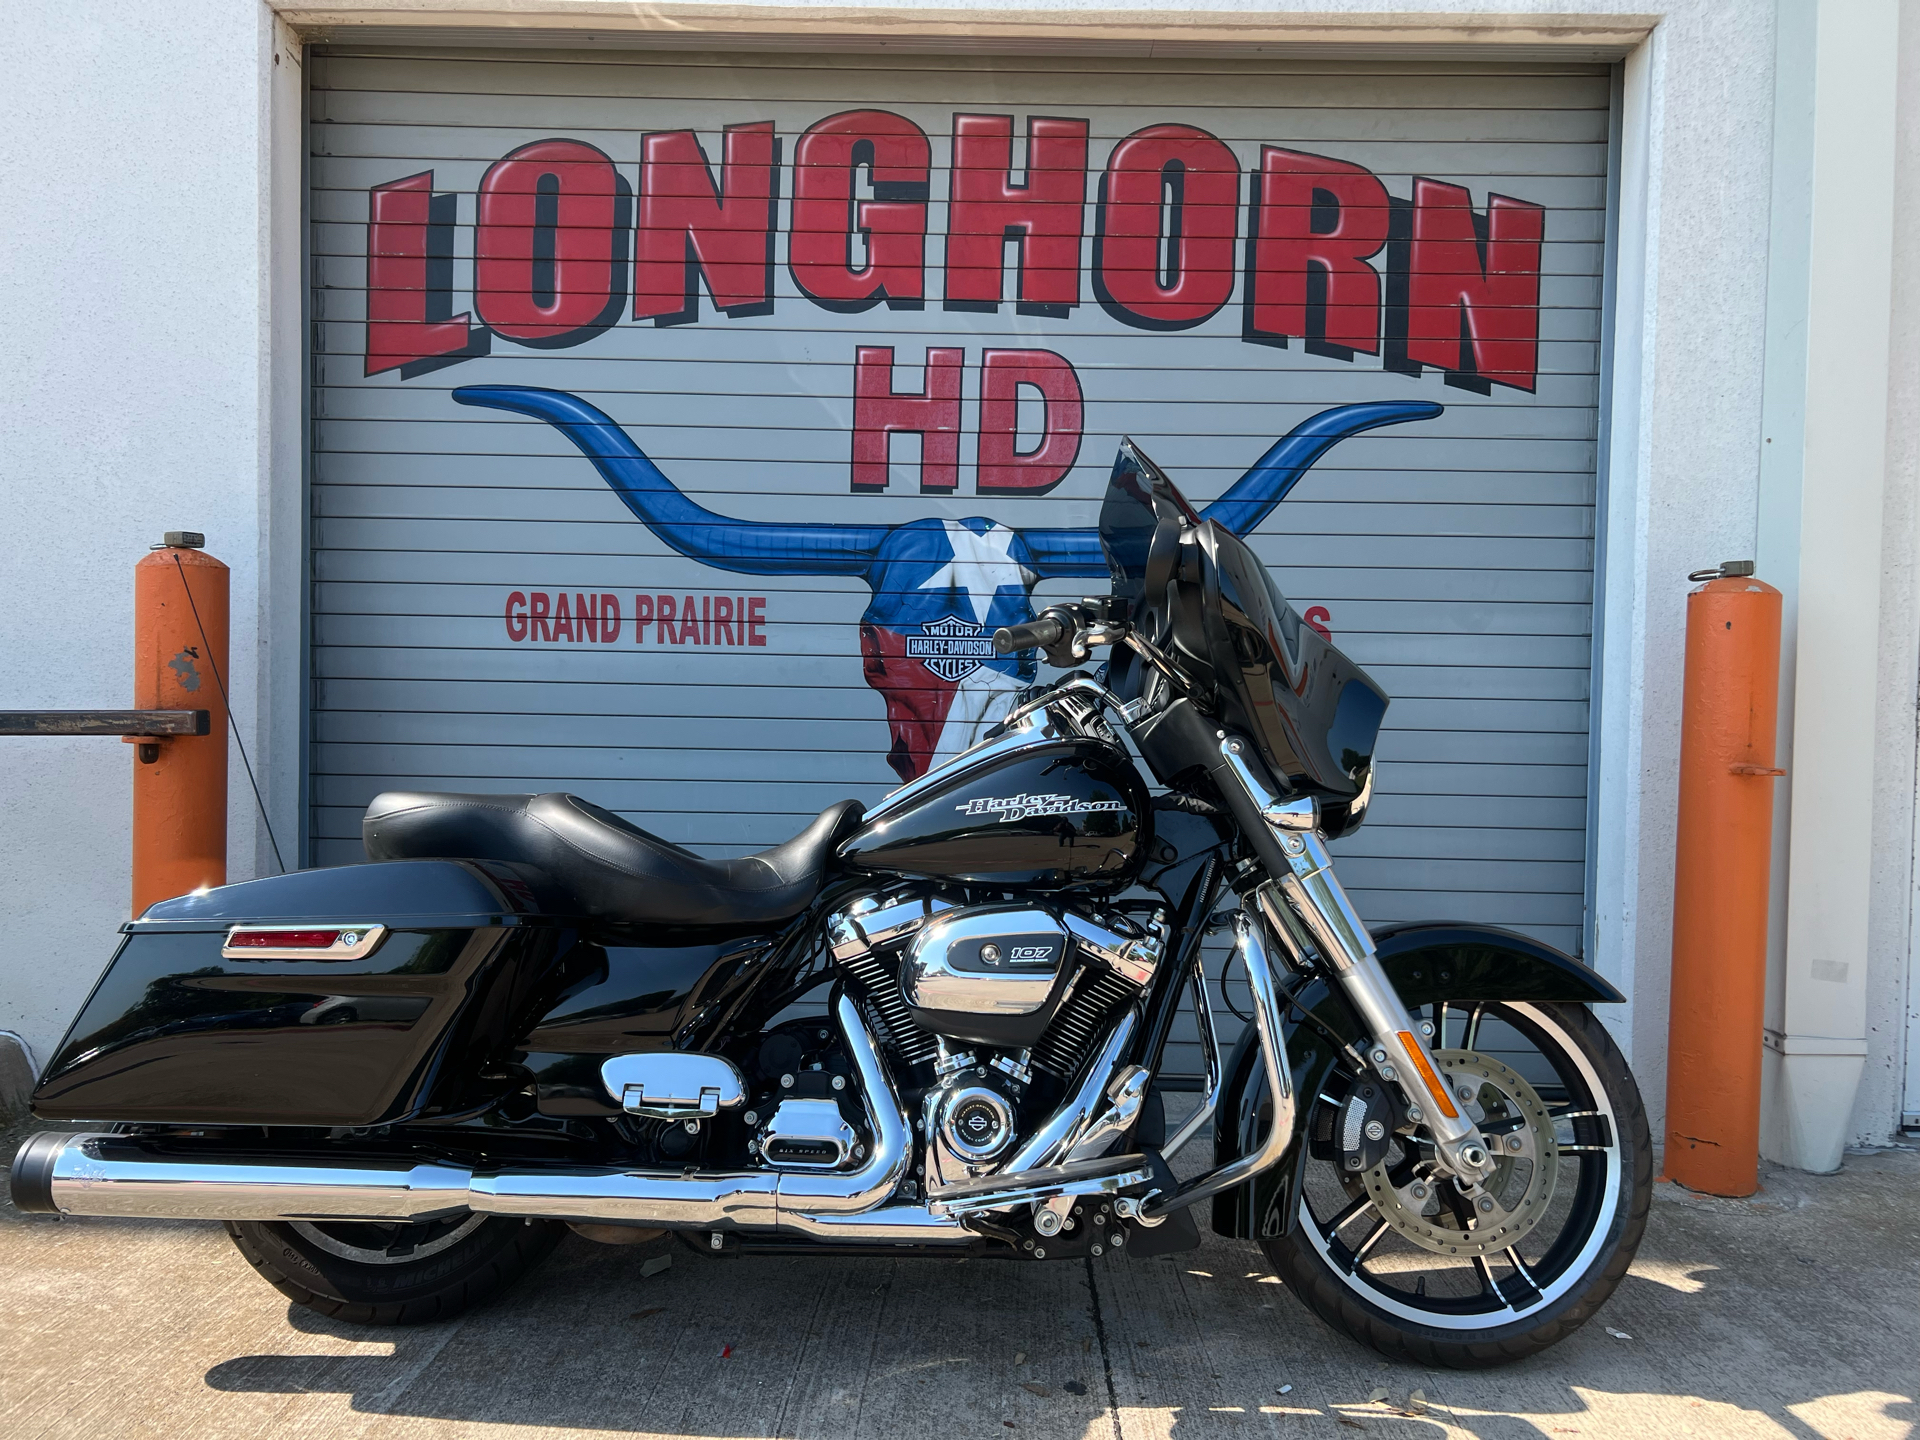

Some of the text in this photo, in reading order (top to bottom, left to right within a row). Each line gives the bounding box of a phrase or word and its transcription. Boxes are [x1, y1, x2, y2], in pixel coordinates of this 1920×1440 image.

[364, 109, 1546, 394] LONGHORN
[850, 345, 1084, 496] HD
[505, 591, 621, 643] GRAND
[635, 594, 767, 646] PRAIRIE
[931, 620, 973, 636] MOTOR
[911, 639, 991, 655] HARLEY-DAVIDSON
[930, 659, 973, 678] CYCLES
[992, 799, 1127, 823] Davidson
[1010, 946, 1053, 959] 107
